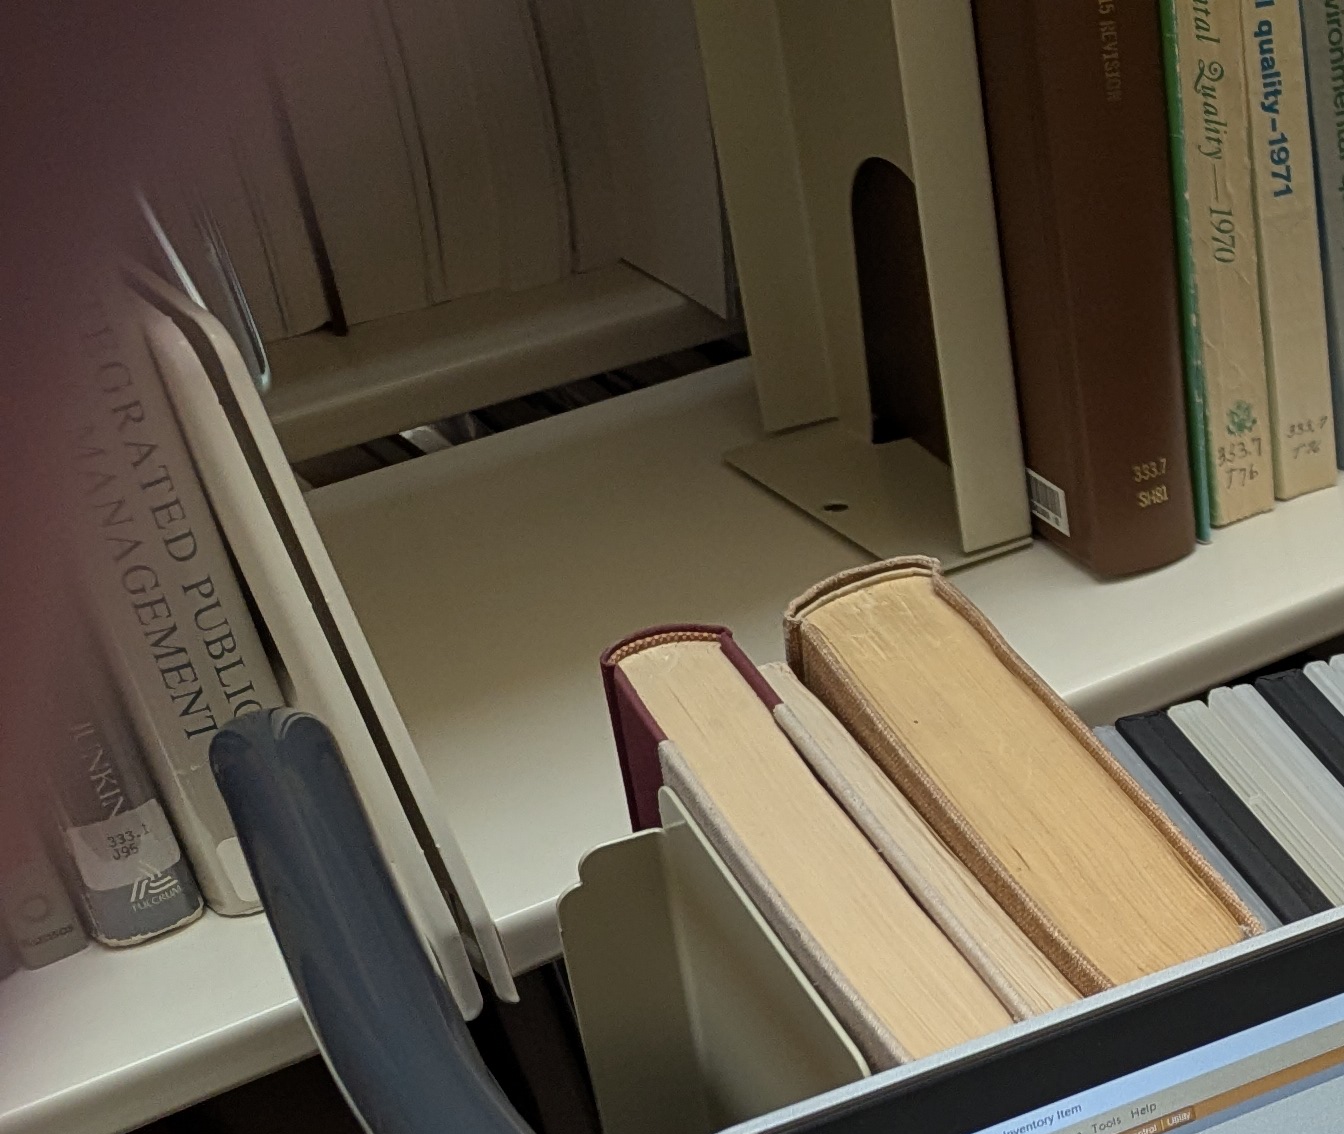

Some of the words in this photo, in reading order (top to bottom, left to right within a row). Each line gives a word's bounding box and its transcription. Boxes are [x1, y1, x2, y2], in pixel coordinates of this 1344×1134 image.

[1131, 457, 1168, 483] 333.7
[1056, 1104, 1082, 1120] Item
[1091, 1116, 1122, 1134] Tools
[1130, 1102, 1157, 1120] Help
